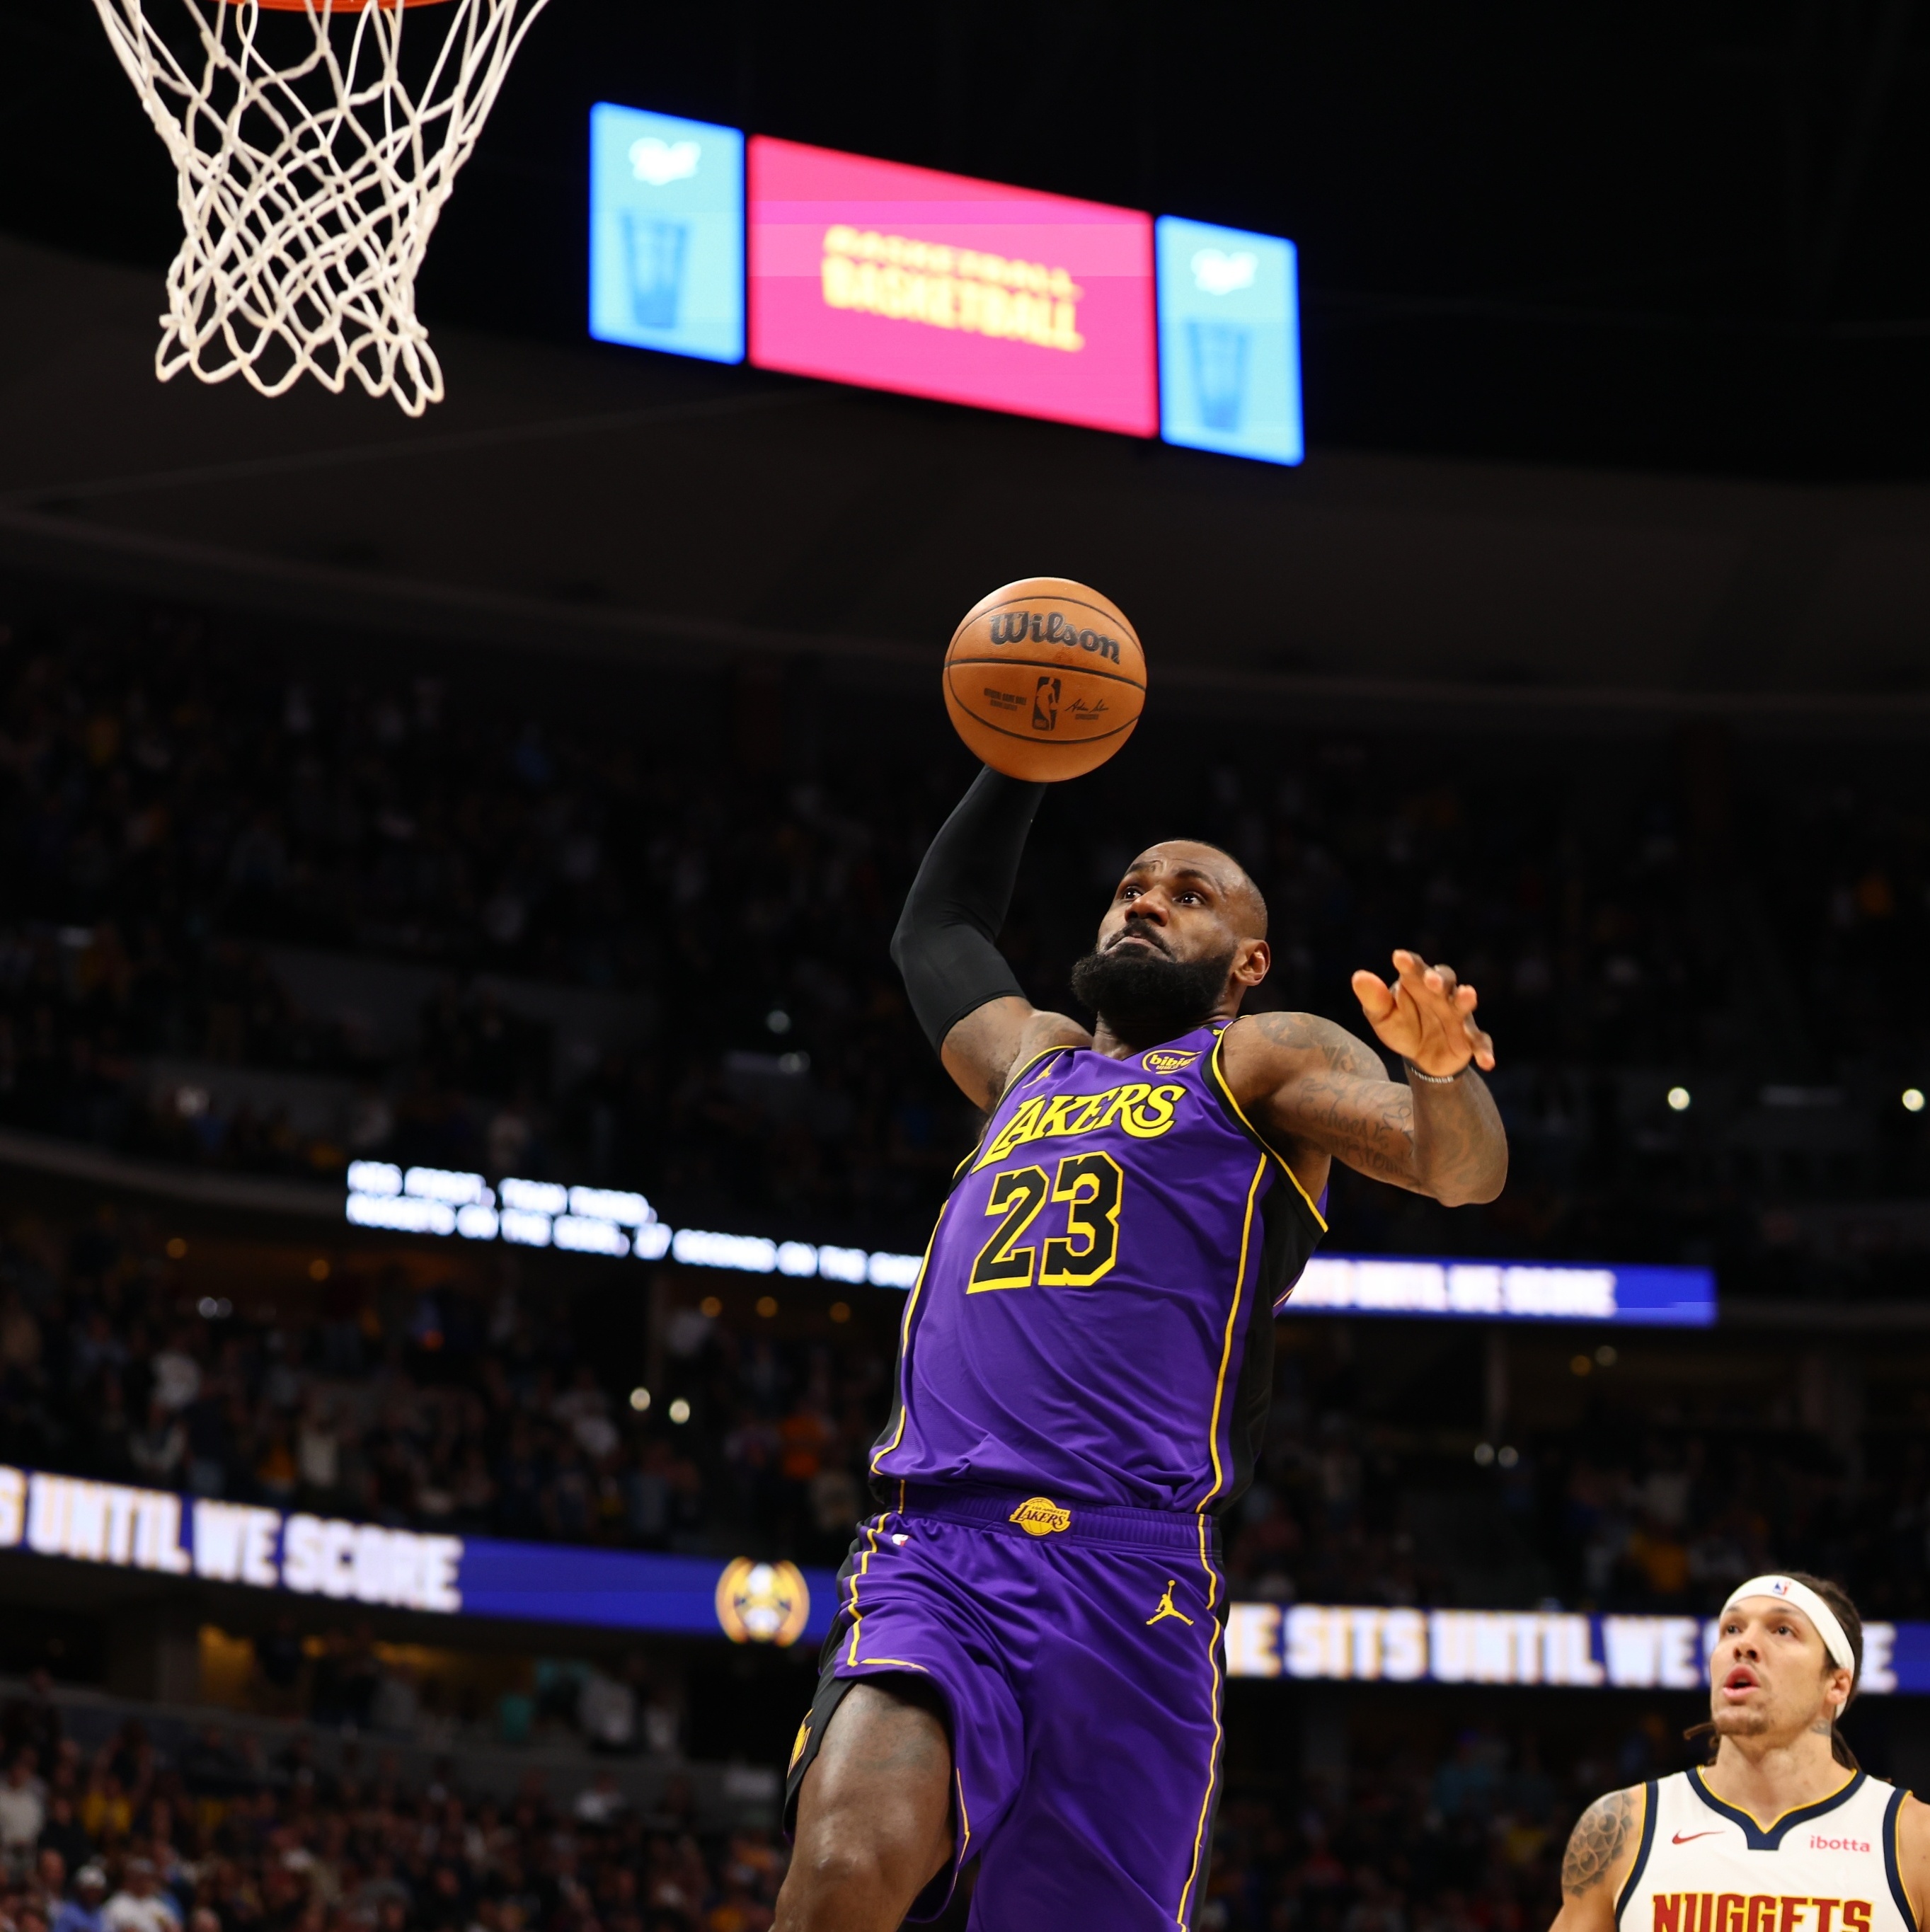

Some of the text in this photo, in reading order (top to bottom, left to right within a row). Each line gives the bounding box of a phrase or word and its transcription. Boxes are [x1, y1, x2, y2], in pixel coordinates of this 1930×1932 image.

[989, 611, 1120, 665] Wilson
[970, 1083, 1187, 1175] LAKERS
[965, 1150, 1124, 1295] 23
[27, 1471, 192, 1576] UNTIL
[192, 1497, 282, 1588] WE
[282, 1512, 464, 1614] SCORE
[1014, 1505, 1068, 1530] LAKERS
[1283, 1602, 1427, 1682] SITS
[1428, 1608, 1604, 1685] UNTIL
[1601, 1614, 1700, 1690] WE
[1810, 1834, 1871, 1853] ibotta
[1653, 1892, 1873, 1932] NUGGETS
